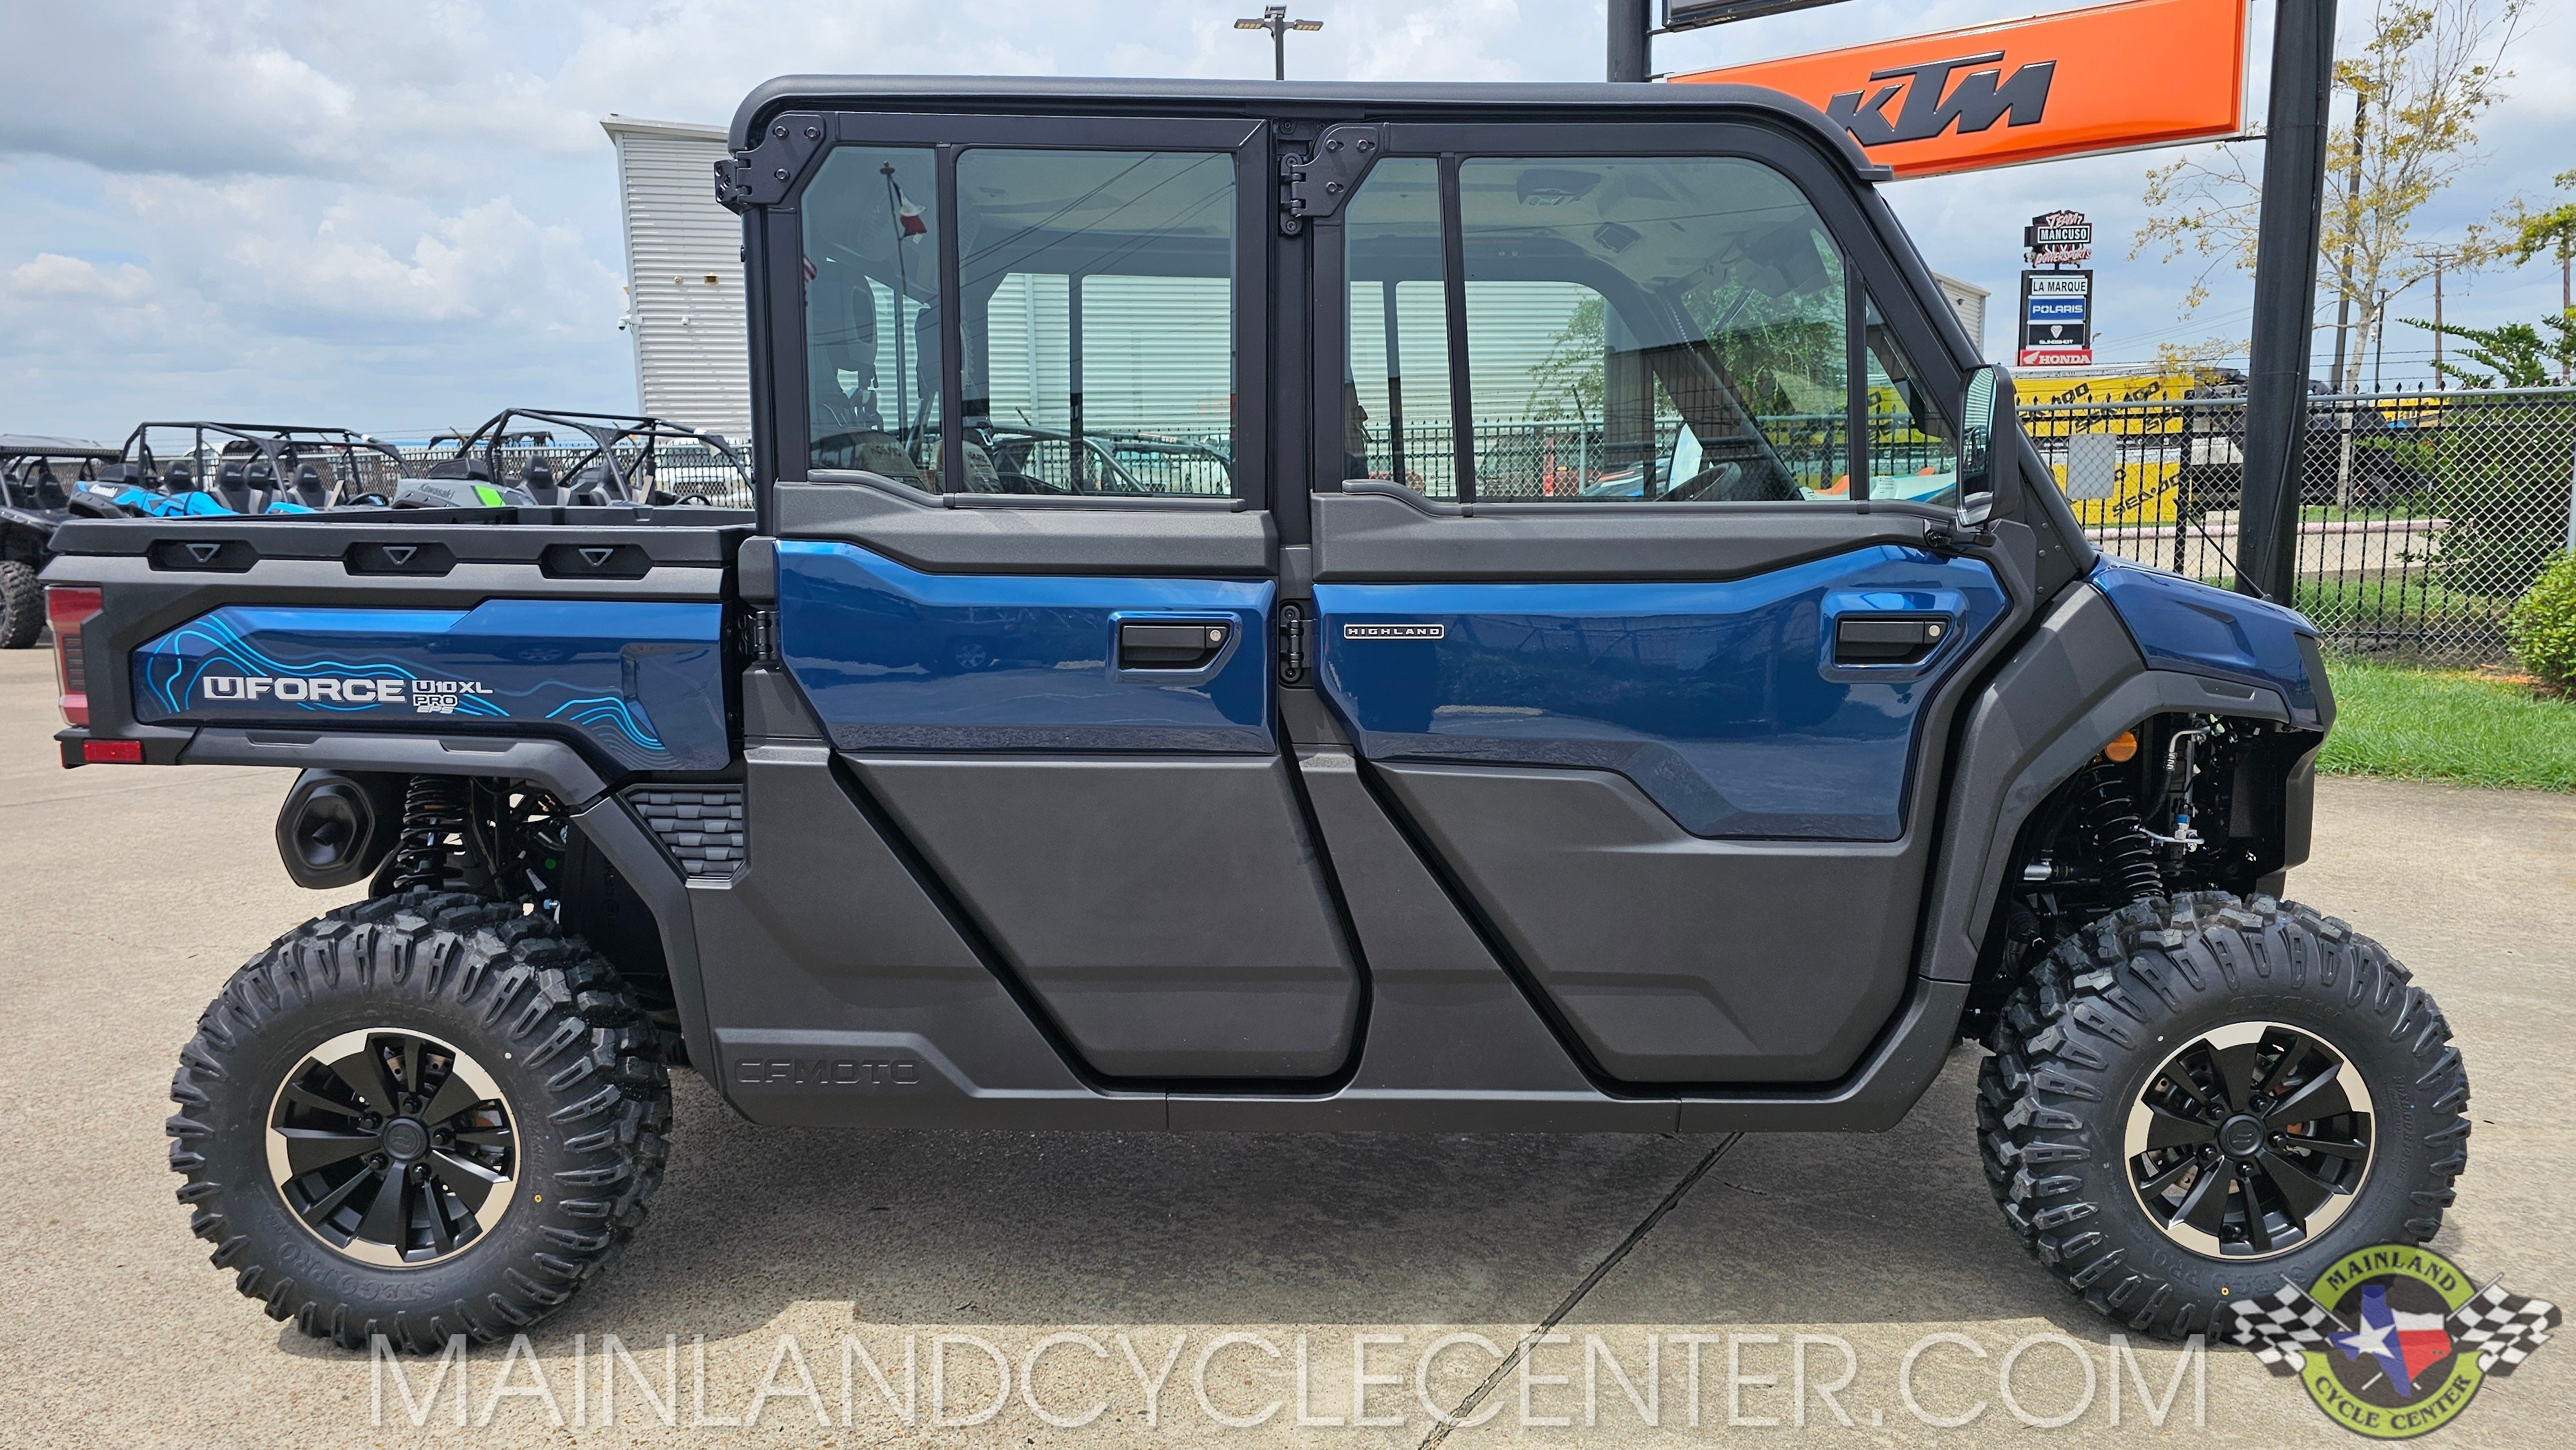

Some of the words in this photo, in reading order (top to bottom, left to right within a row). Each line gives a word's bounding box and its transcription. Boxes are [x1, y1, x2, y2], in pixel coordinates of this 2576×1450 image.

[1825, 50, 2057, 147] KTM
[2048, 212, 2079, 229] TEAM
[2040, 229, 2087, 240] MANCUSO
[2034, 249, 2092, 267] POWERSPORTS
[2033, 281, 2044, 292] LA
[2048, 281, 2086, 292] MARQUE
[2032, 305, 2083, 314] POLARIS
[2038, 355, 2092, 364] HONDA
[203, 676, 406, 703] UFORCE
[413, 694, 459, 707] PRO
[416, 706, 454, 714] EPS
[734, 1059, 921, 1085] CFMOTO
